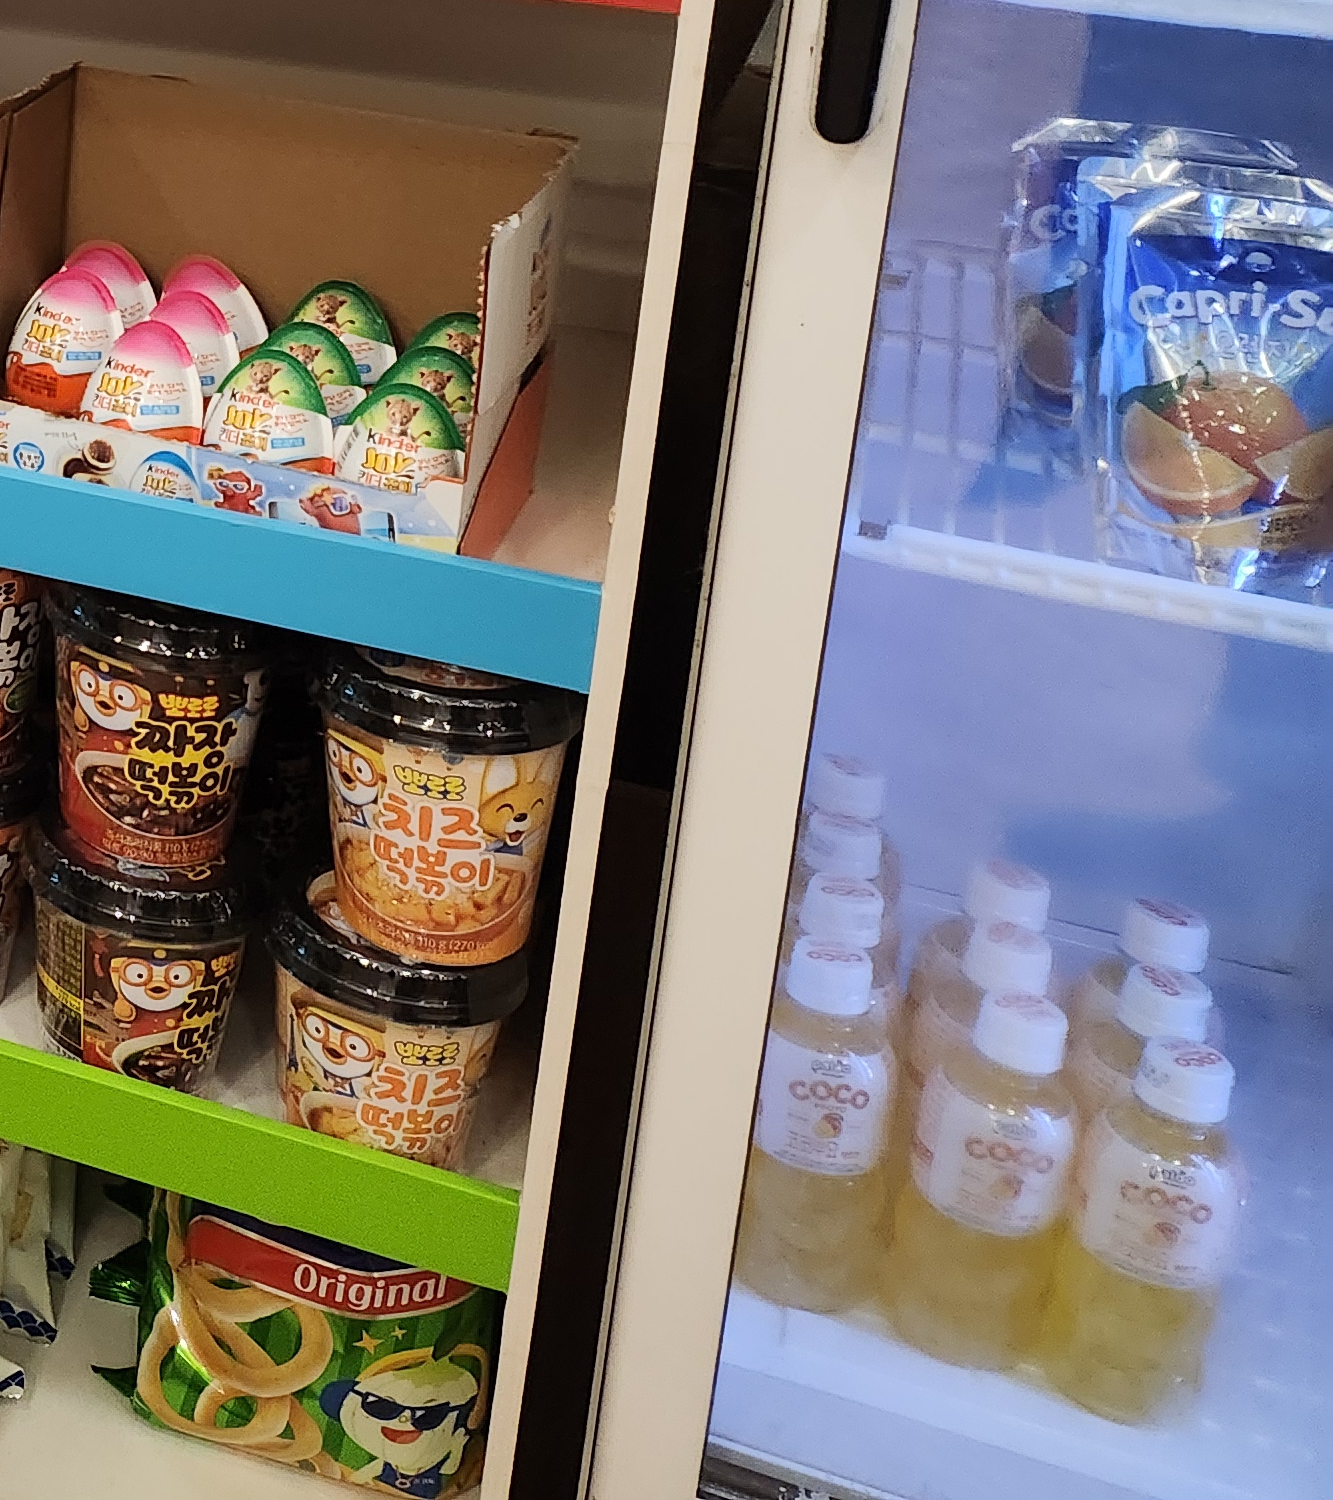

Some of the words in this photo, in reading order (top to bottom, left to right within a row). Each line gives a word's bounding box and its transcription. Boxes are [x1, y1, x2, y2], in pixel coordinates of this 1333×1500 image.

[104, 356, 155, 378] kinder
[229, 388, 280, 410] kinder
[367, 427, 422, 453] kinder
[158, 694, 220, 718] 뽀로로
[133, 718, 238, 772] 짜장
[126, 757, 231, 809] 떡볶이
[393, 764, 468, 800] 뽀로로
[379, 804, 483, 852] 치즈
[372, 834, 496, 898] 떡볶이
[395, 1040, 461, 1067] 뽀로로
[373, 1068, 468, 1106] 치즈
[357, 1099, 465, 1154] 떡볶이
[292, 1261, 447, 1308] Original
